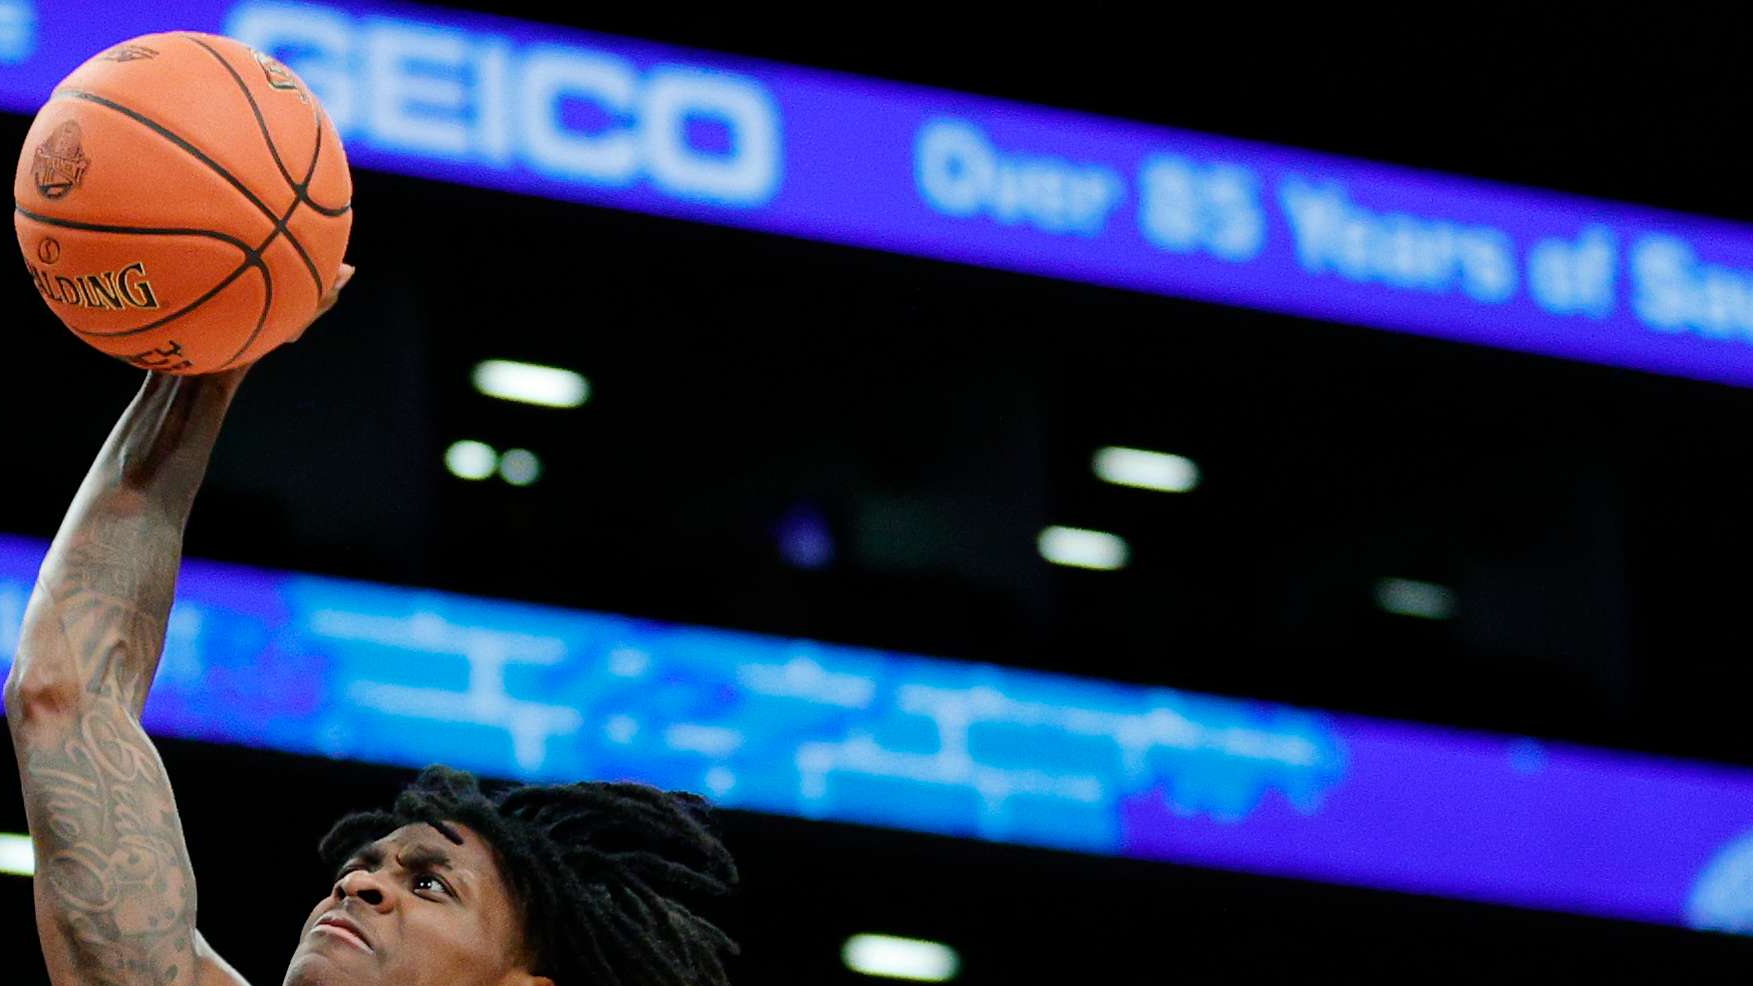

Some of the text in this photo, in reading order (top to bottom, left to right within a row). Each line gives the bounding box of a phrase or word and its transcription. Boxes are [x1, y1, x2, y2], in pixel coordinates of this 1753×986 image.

[916, 117, 1120, 238] Over
[1280, 177, 1513, 303] Years
[1529, 227, 1615, 318] of
